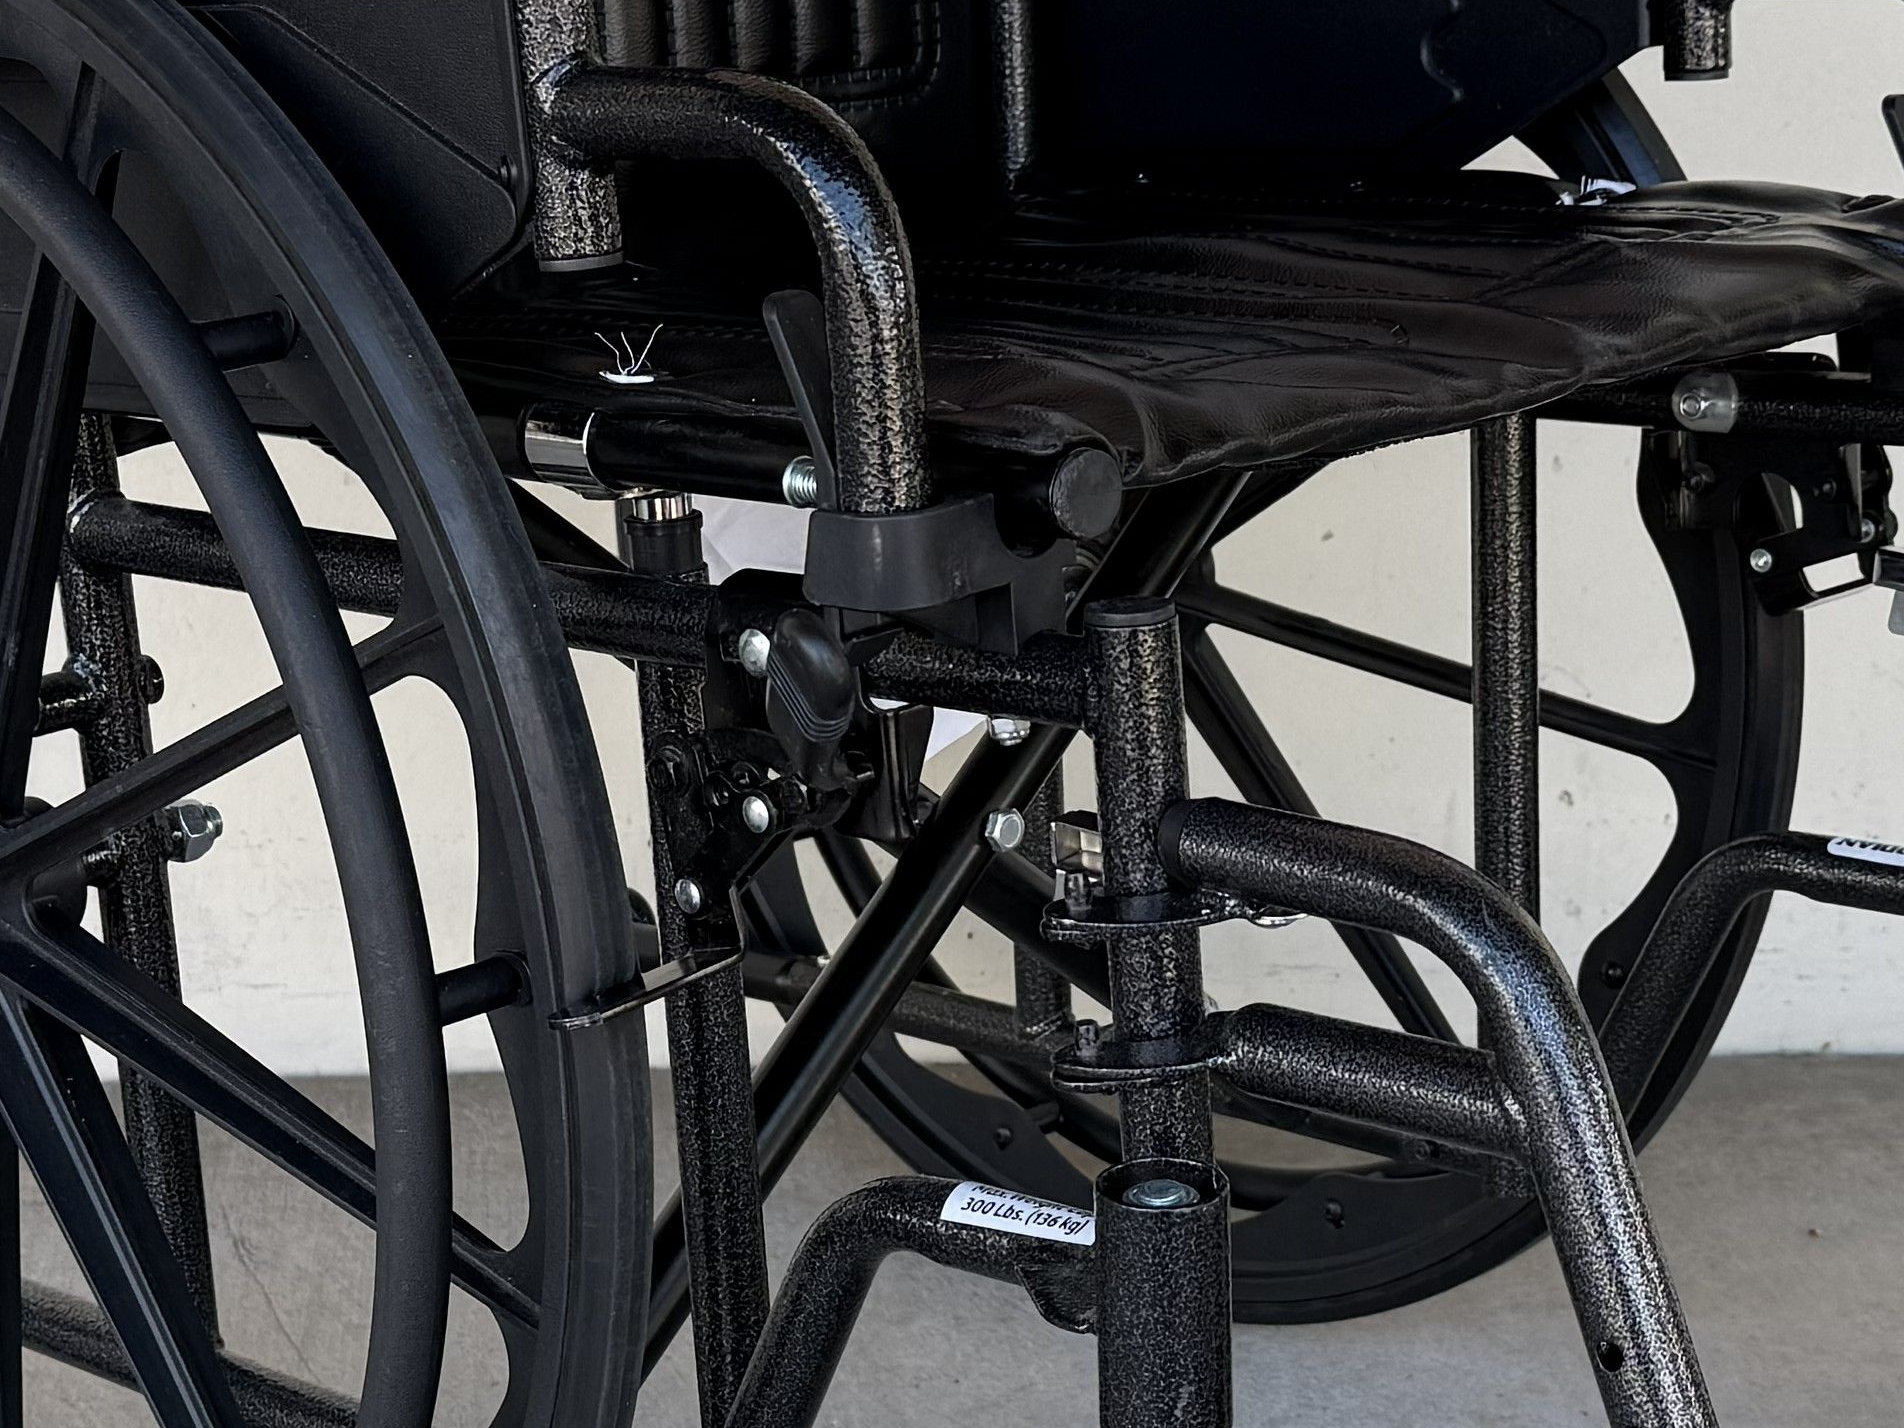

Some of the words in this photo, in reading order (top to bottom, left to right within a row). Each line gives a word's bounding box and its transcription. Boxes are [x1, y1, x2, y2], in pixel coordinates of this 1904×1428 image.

[960, 1197, 996, 1215] 300
[995, 1203, 1023, 1222] Lbs.
[1024, 1209, 1062, 1228] (136
